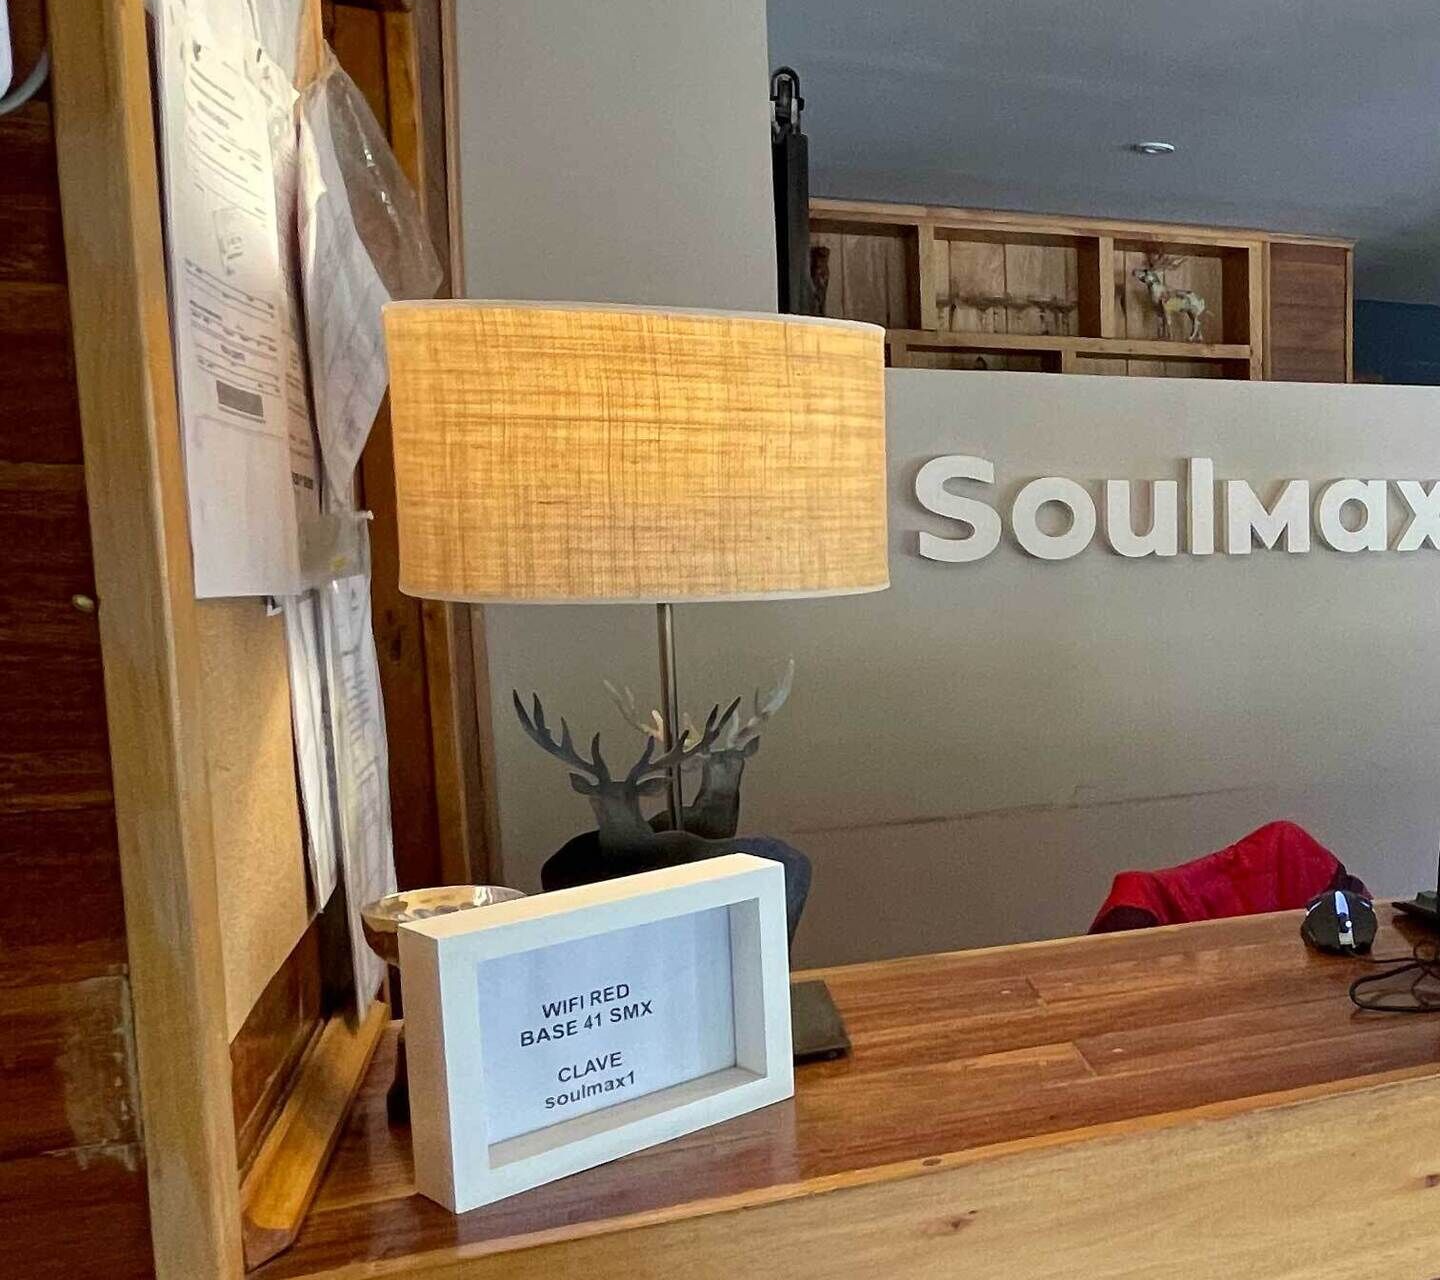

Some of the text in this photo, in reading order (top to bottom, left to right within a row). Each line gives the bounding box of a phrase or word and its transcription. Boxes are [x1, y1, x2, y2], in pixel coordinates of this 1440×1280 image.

[542, 983, 630, 1019] WIFI RED
[520, 999, 653, 1047] BASE 41 SMX
[557, 1051, 623, 1083] CLAVE
[545, 1070, 635, 1109] soulmax1
